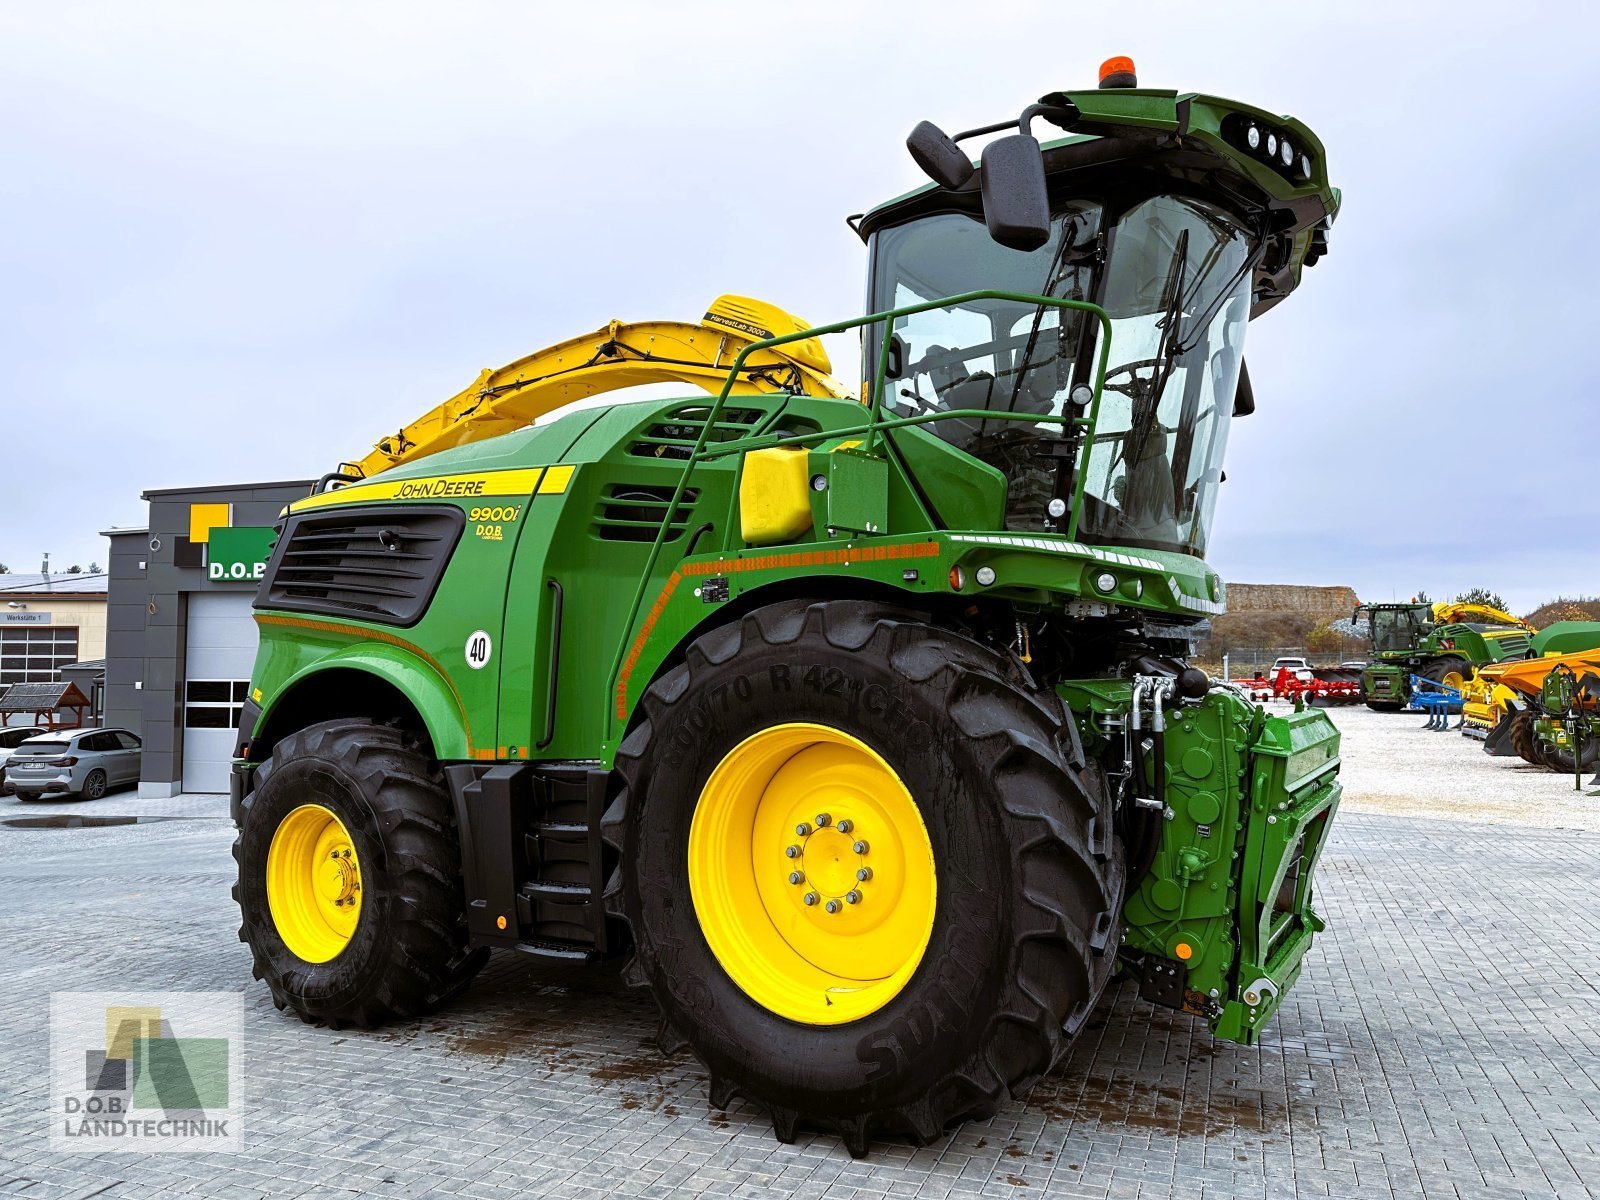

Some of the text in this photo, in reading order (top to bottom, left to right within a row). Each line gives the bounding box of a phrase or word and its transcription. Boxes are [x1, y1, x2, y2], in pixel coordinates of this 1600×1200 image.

[710, 314, 766, 337] HarvestLab 3000
[393, 480, 486, 498] JOHN DEERE
[468, 504, 522, 523] 9900i
[475, 524, 503, 537] D.O.B.
[470, 637, 486, 663] 40
[769, 664, 792, 694] R
